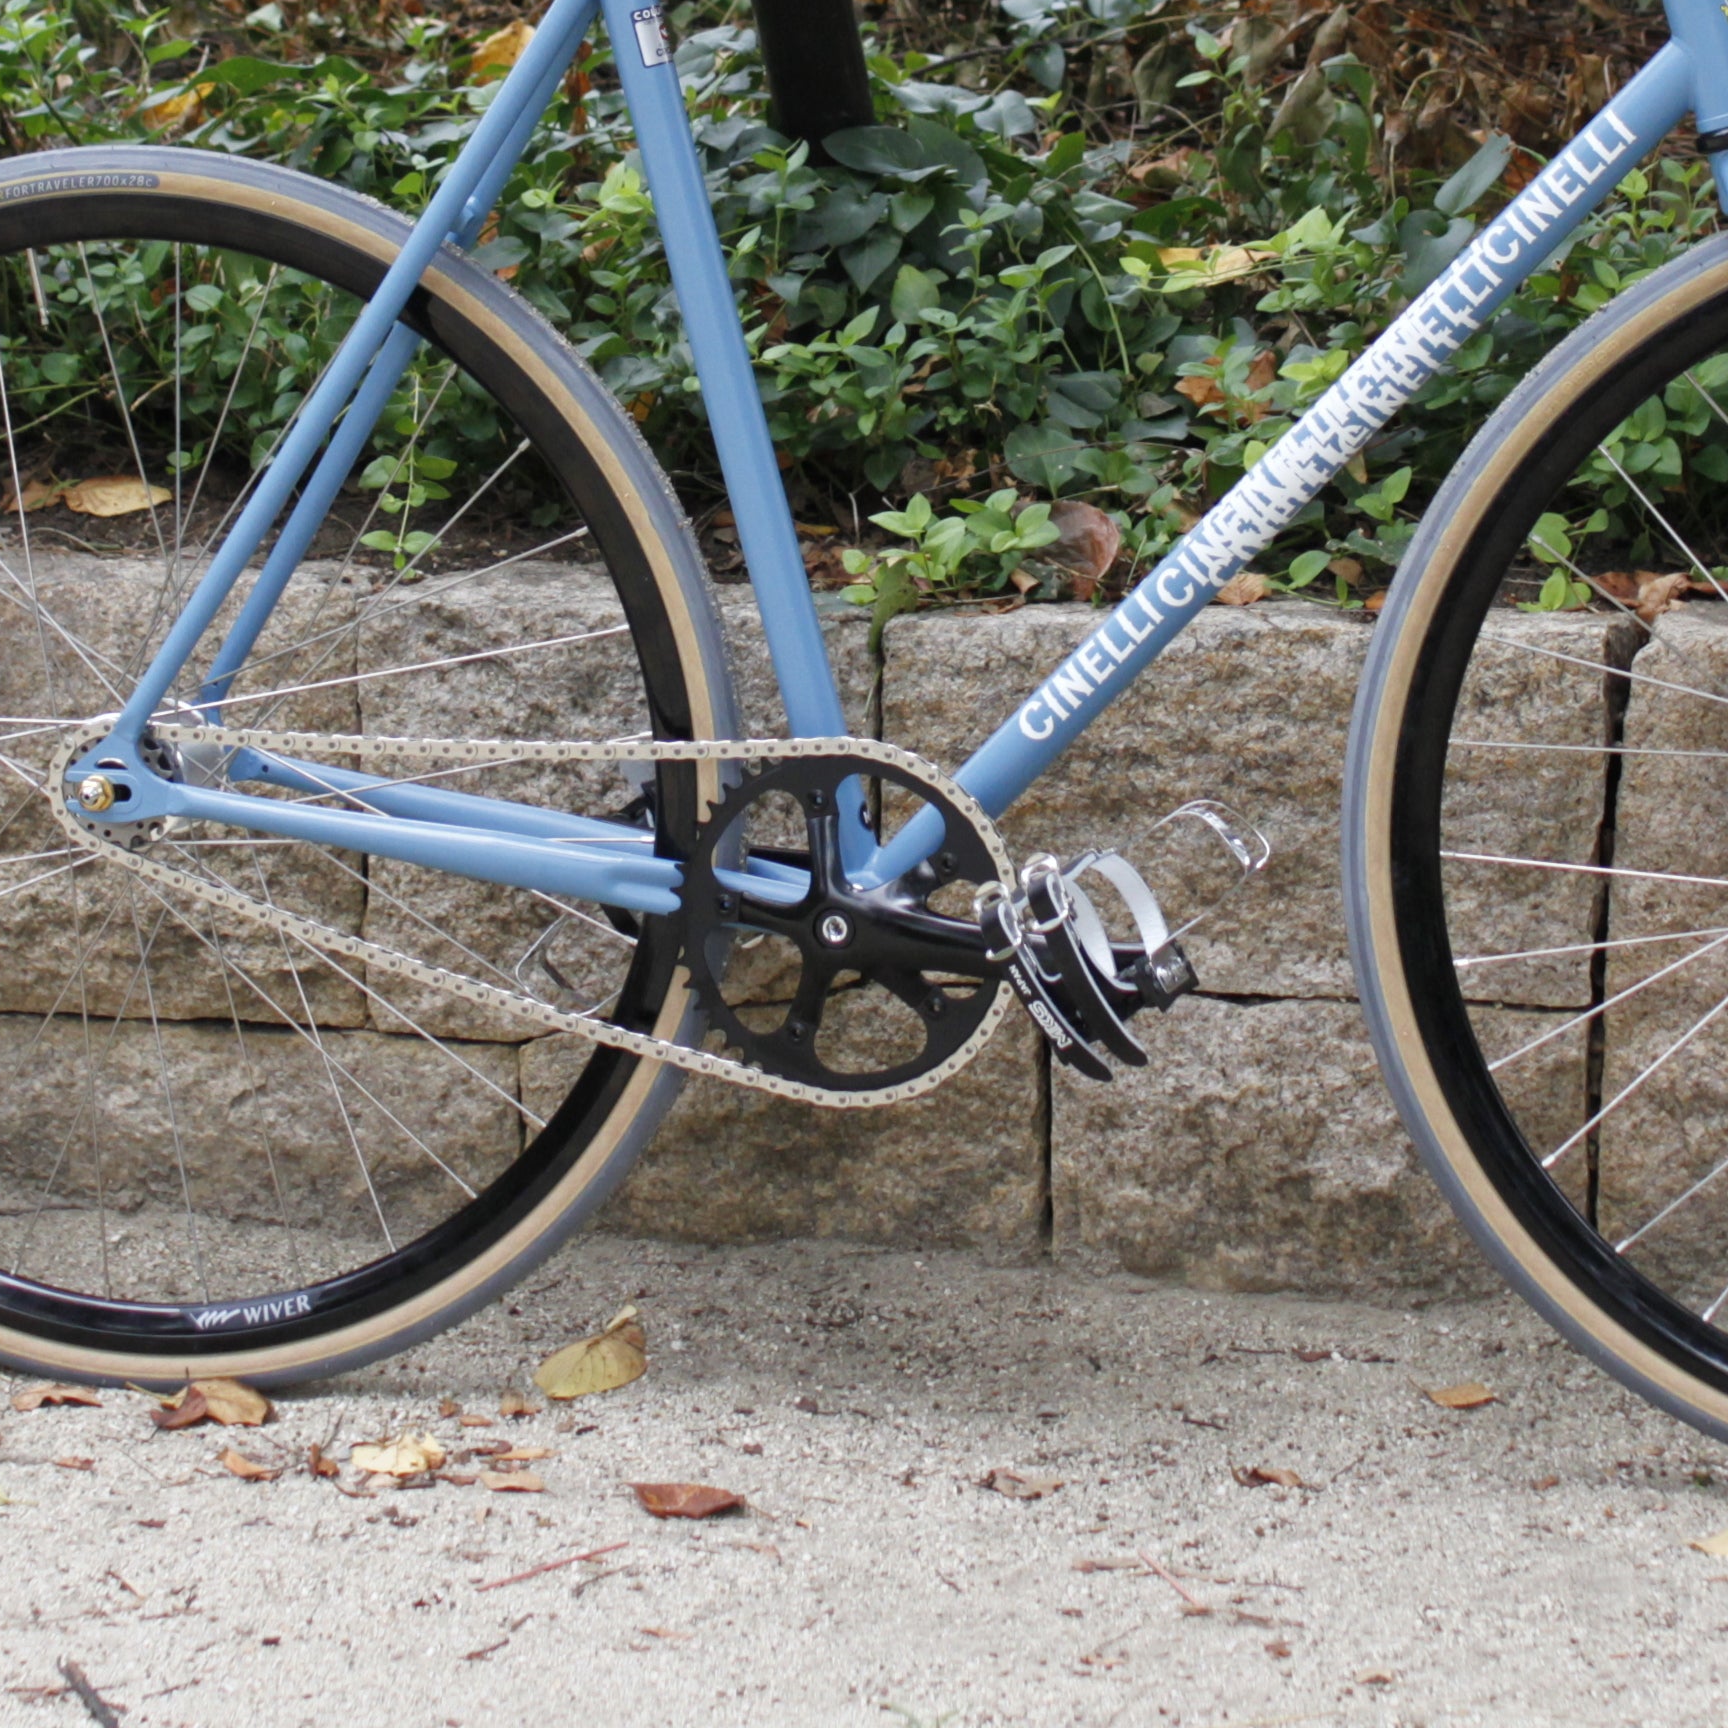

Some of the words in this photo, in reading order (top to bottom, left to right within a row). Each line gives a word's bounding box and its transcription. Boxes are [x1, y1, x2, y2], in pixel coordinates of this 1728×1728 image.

[1482, 109, 1637, 264] CINELLI
[1018, 590, 1164, 741] CINELLI
[1009, 963, 1032, 996] JAPAN
[1028, 1000, 1073, 1049] MKS
[243, 1294, 312, 1324] WIVER
